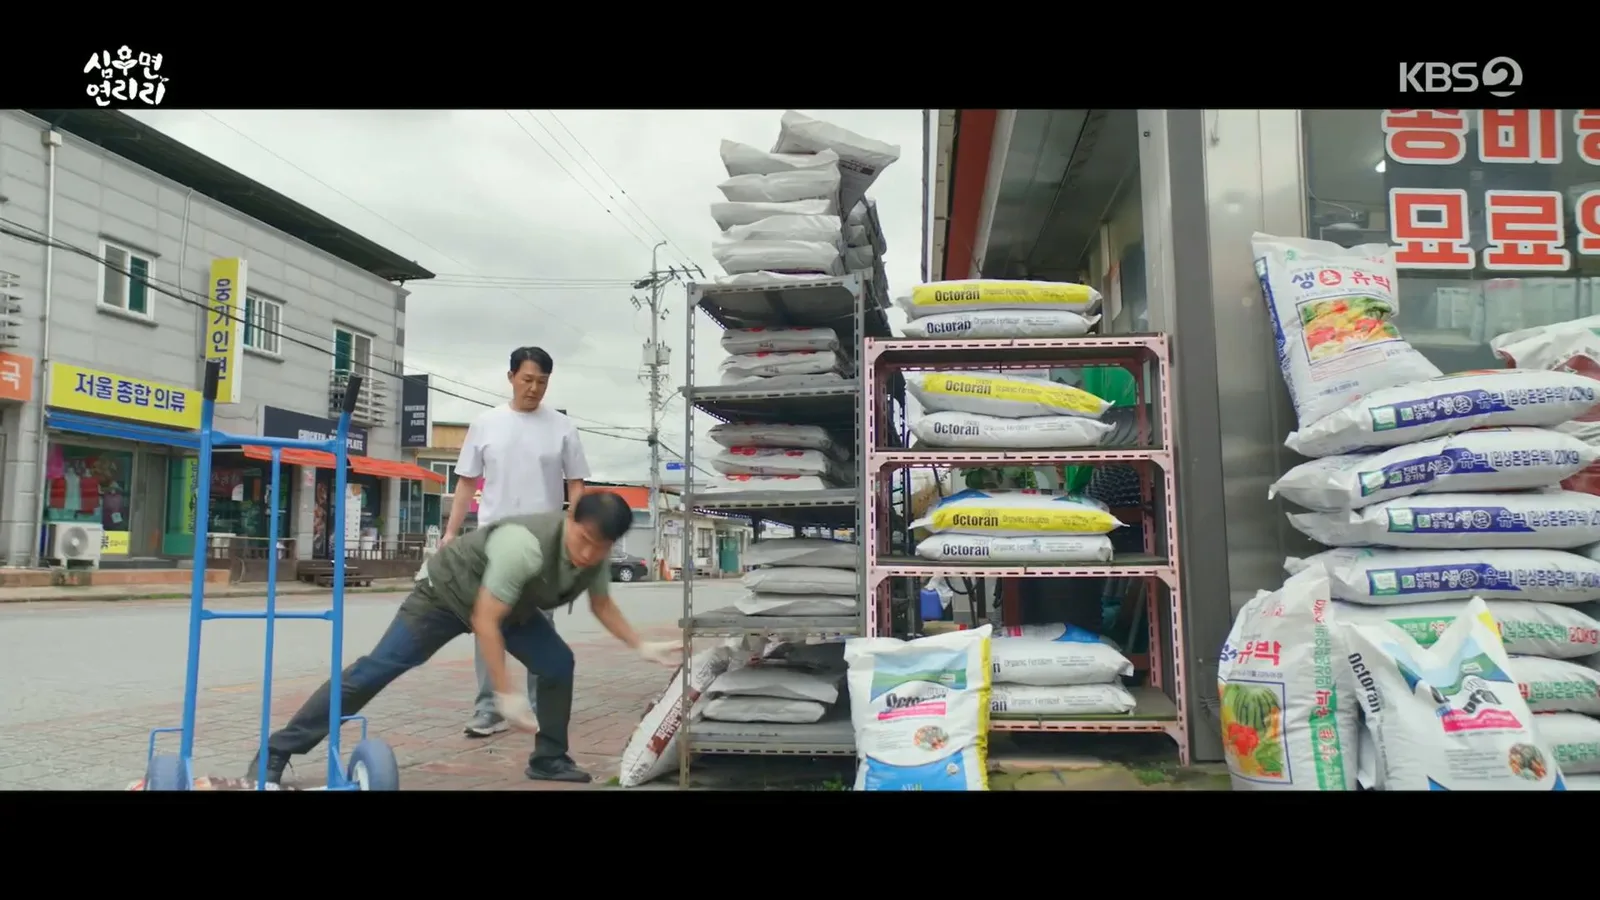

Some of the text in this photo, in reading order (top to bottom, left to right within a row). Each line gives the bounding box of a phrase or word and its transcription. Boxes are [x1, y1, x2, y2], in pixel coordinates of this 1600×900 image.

[1291, 270, 1392, 293] 생 유박
[935, 290, 980, 302] Octoran
[927, 321, 972, 334] Octoran
[75, 372, 186, 413] 저울 종합 의류
[945, 379, 991, 395] Octoran
[934, 421, 979, 436] Octoran
[1458, 451, 1489, 469] 유박
[953, 514, 998, 527] Octoran
[943, 544, 989, 556] Octoran
[1238, 639, 1282, 667] 유박
[1348, 652, 1382, 713] Octoran
